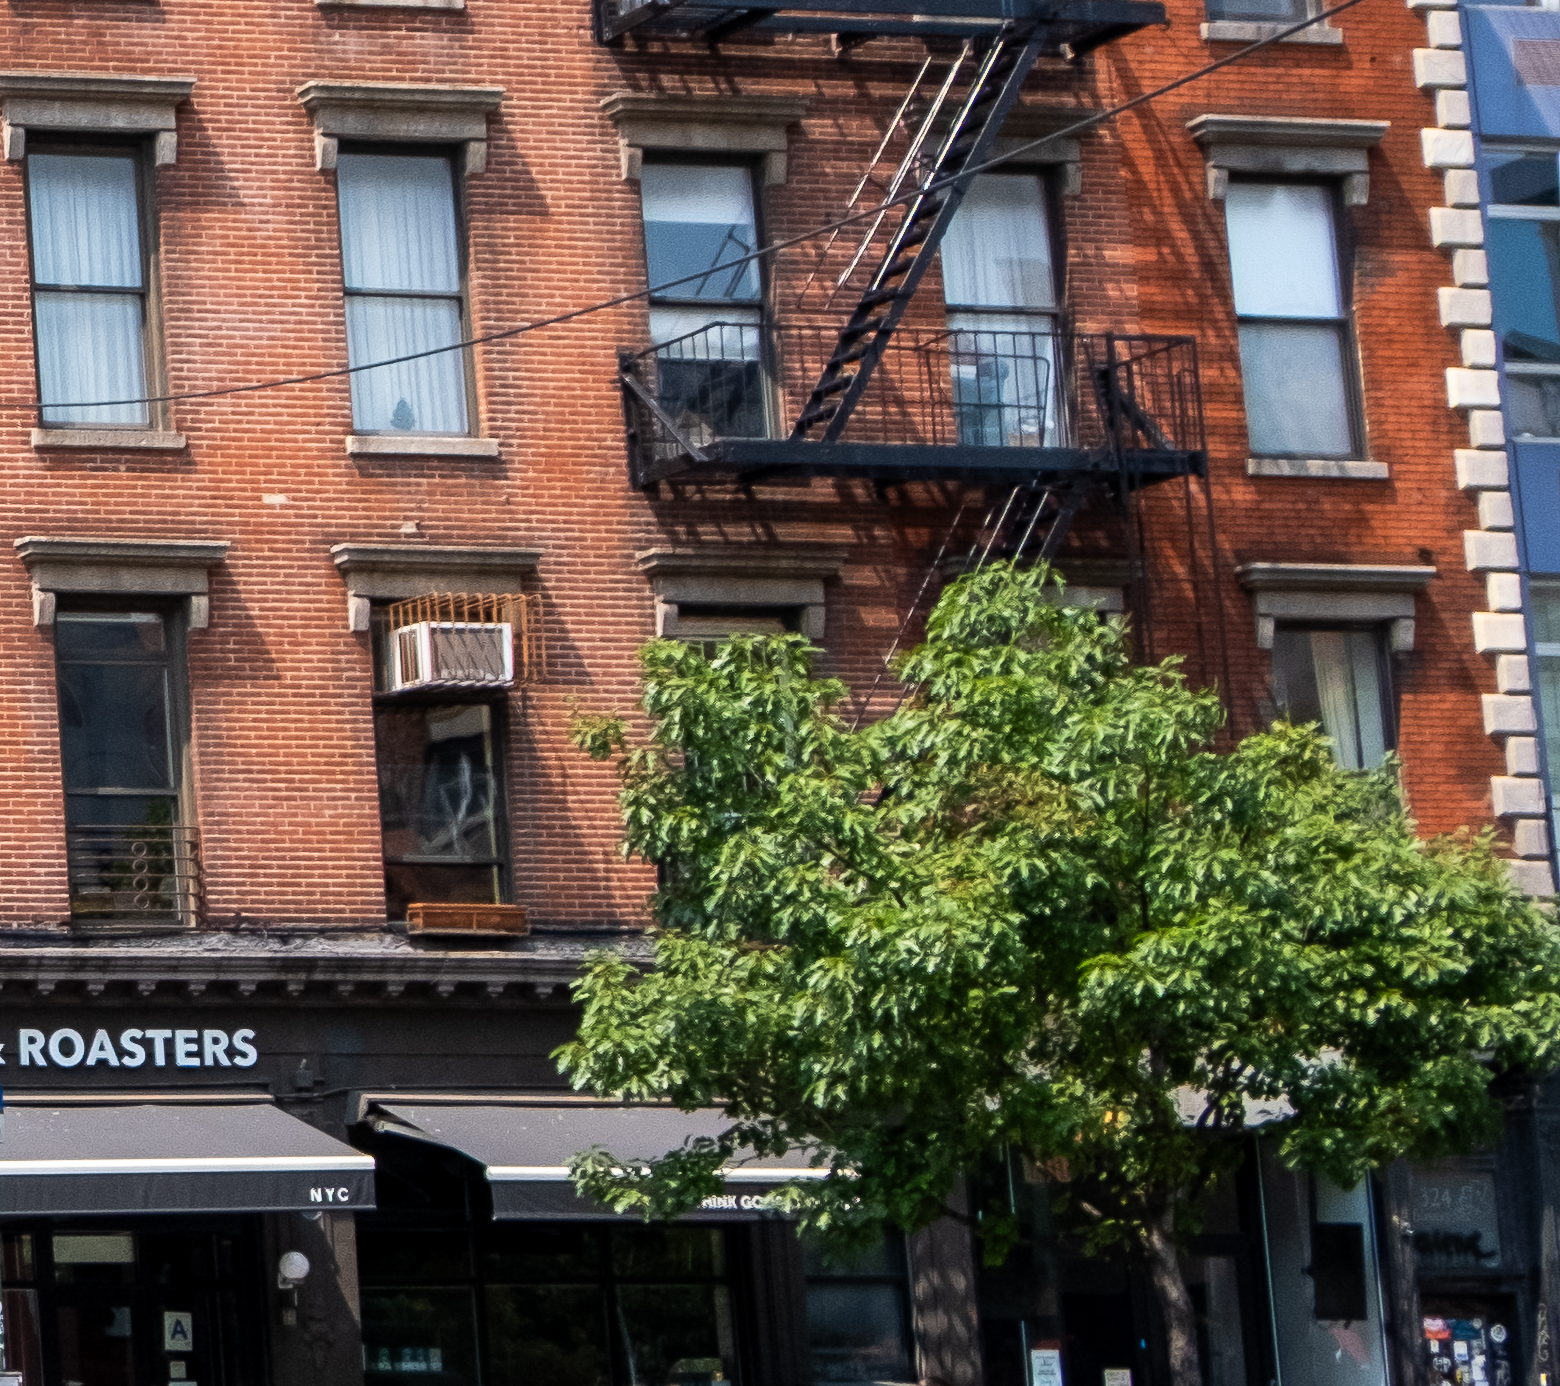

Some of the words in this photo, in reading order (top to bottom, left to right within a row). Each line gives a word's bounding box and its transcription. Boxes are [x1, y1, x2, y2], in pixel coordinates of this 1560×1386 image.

[19, 1027, 259, 1068] ROASTERS
[310, 1187, 349, 1202] NYC
[171, 1318, 188, 1341] A
